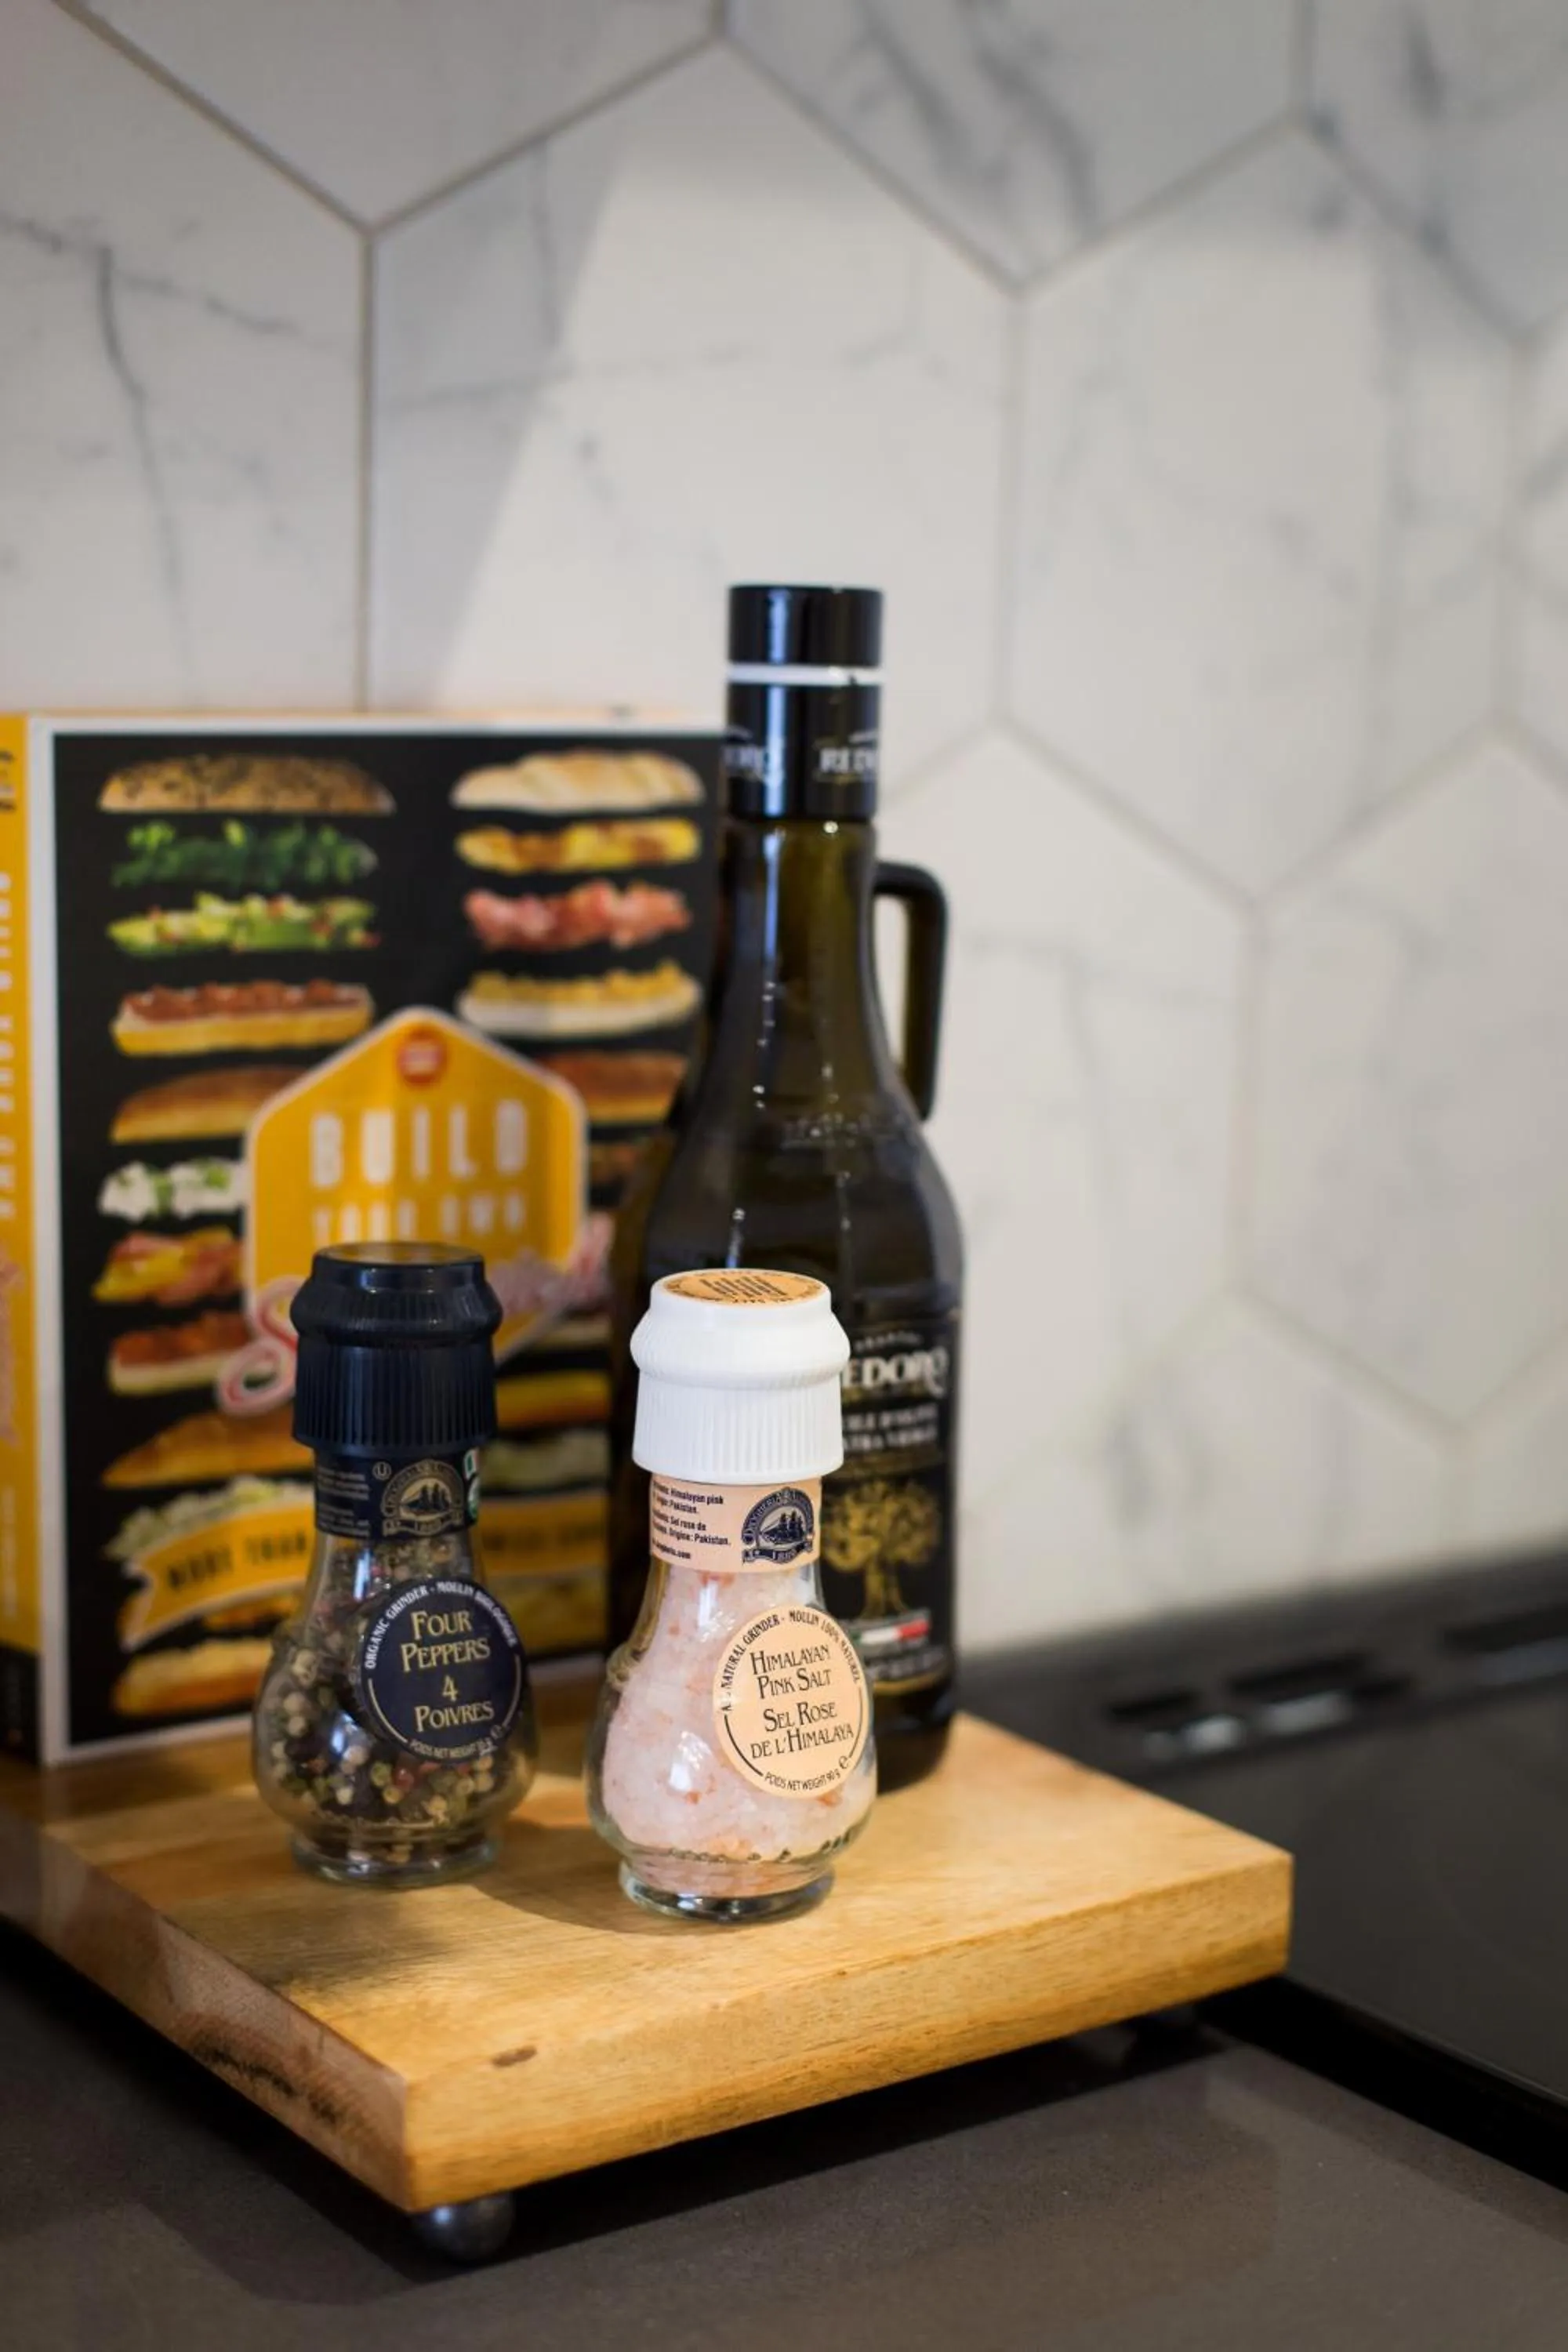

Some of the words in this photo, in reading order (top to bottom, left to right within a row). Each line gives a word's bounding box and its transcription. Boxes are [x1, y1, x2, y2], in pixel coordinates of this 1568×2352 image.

[310, 1099, 528, 1189] BUILD
[365, 1618, 390, 1670] ORGANIC
[385, 1584, 429, 1620] GRINDER
[437, 1581, 474, 1597] MOULIN
[411, 1610, 473, 1641] FOUR
[401, 1637, 492, 1672] PEPPERS
[720, 1644, 747, 1690] NATURAL
[743, 1613, 781, 1645] GRINDER
[789, 1610, 820, 1627] MOULIN
[750, 1644, 831, 1675] HIMALAYAN
[441, 1675, 459, 1702] 4
[757, 1675, 799, 1699] PINK
[797, 1668, 833, 1691] SALT
[414, 1700, 495, 1733] POIVRES
[763, 1708, 795, 1732] SEL
[797, 1700, 838, 1726] ROSE
[750, 1740, 772, 1759] DE
[764, 1771, 786, 1790] POIDS
[786, 1780, 801, 1791] NET
[802, 1775, 827, 1791] WEIGHT
